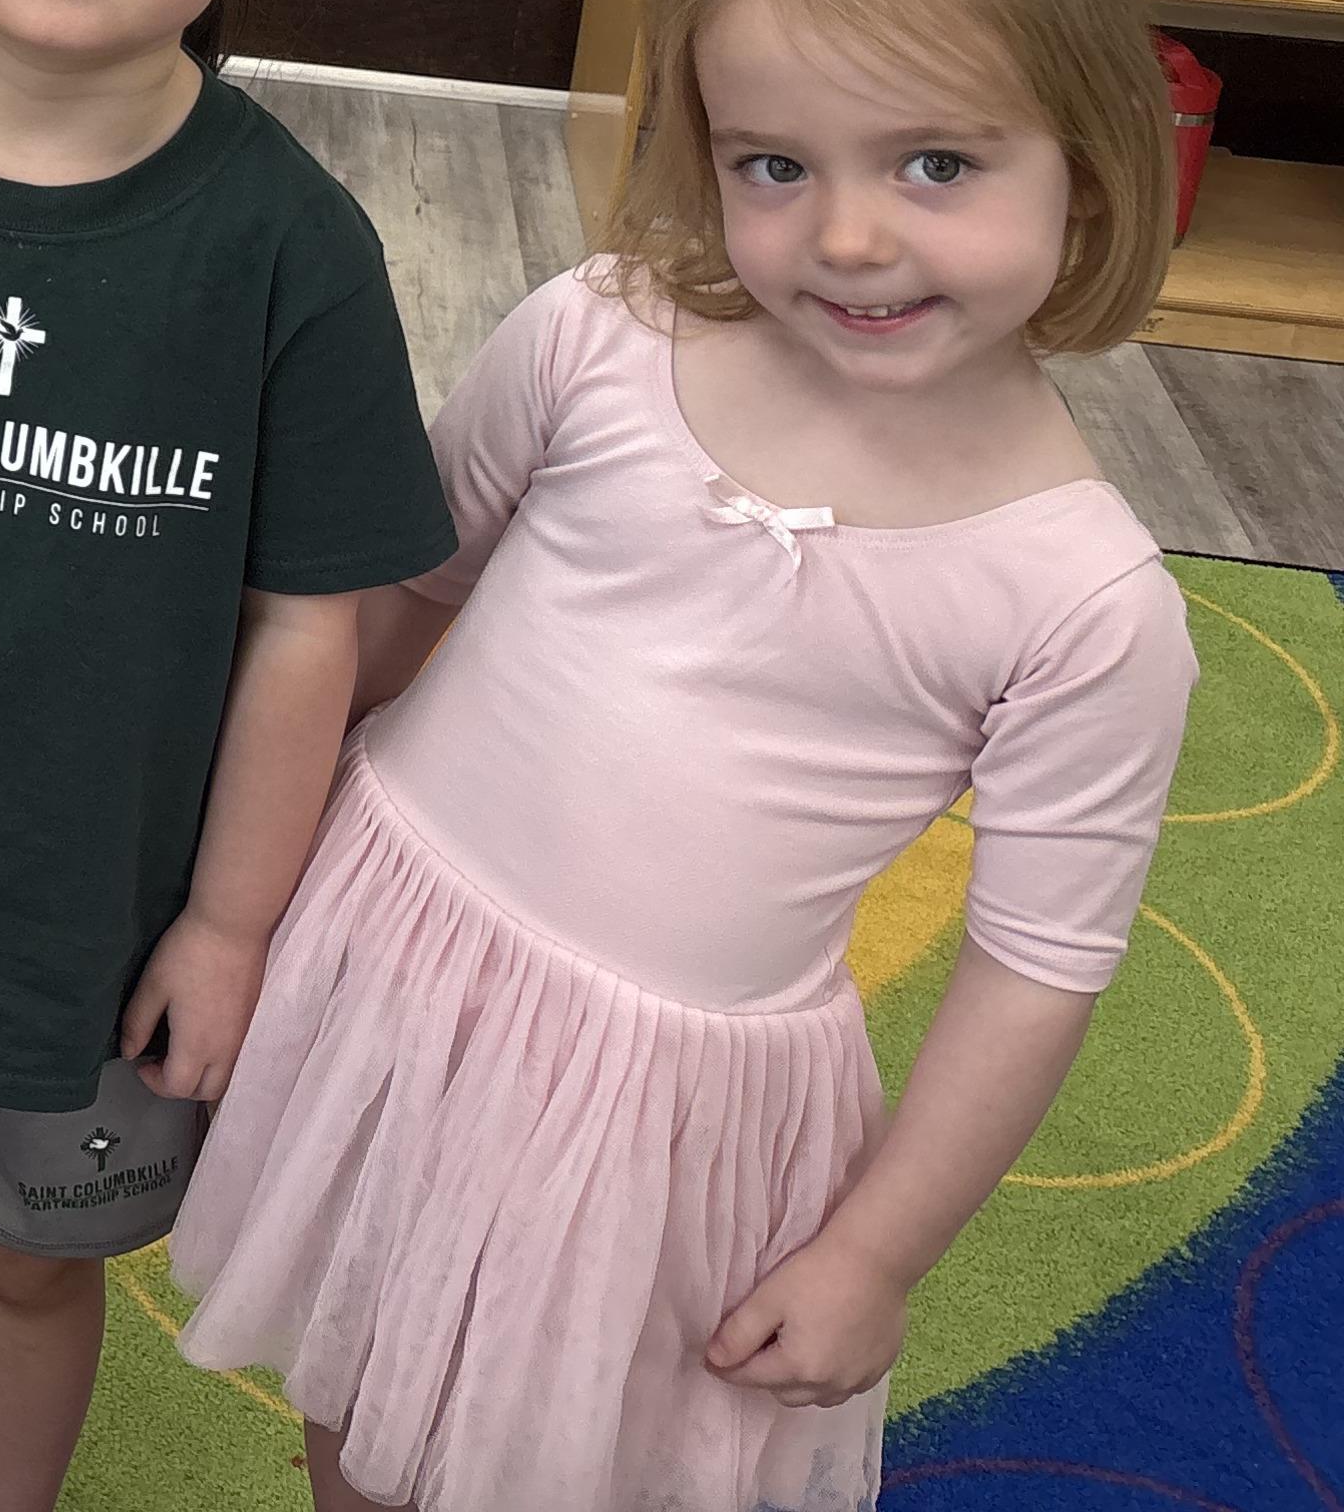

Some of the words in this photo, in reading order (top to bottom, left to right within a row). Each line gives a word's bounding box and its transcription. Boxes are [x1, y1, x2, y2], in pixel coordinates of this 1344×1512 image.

[48, 502, 162, 537] SCHOOL
[18, 1181, 68, 1200] SAINT
[73, 1156, 180, 1199] COLUMBKILLE
[23, 1189, 120, 1212] PARTNERSHIP
[123, 1175, 172, 1199] SCHOOL
